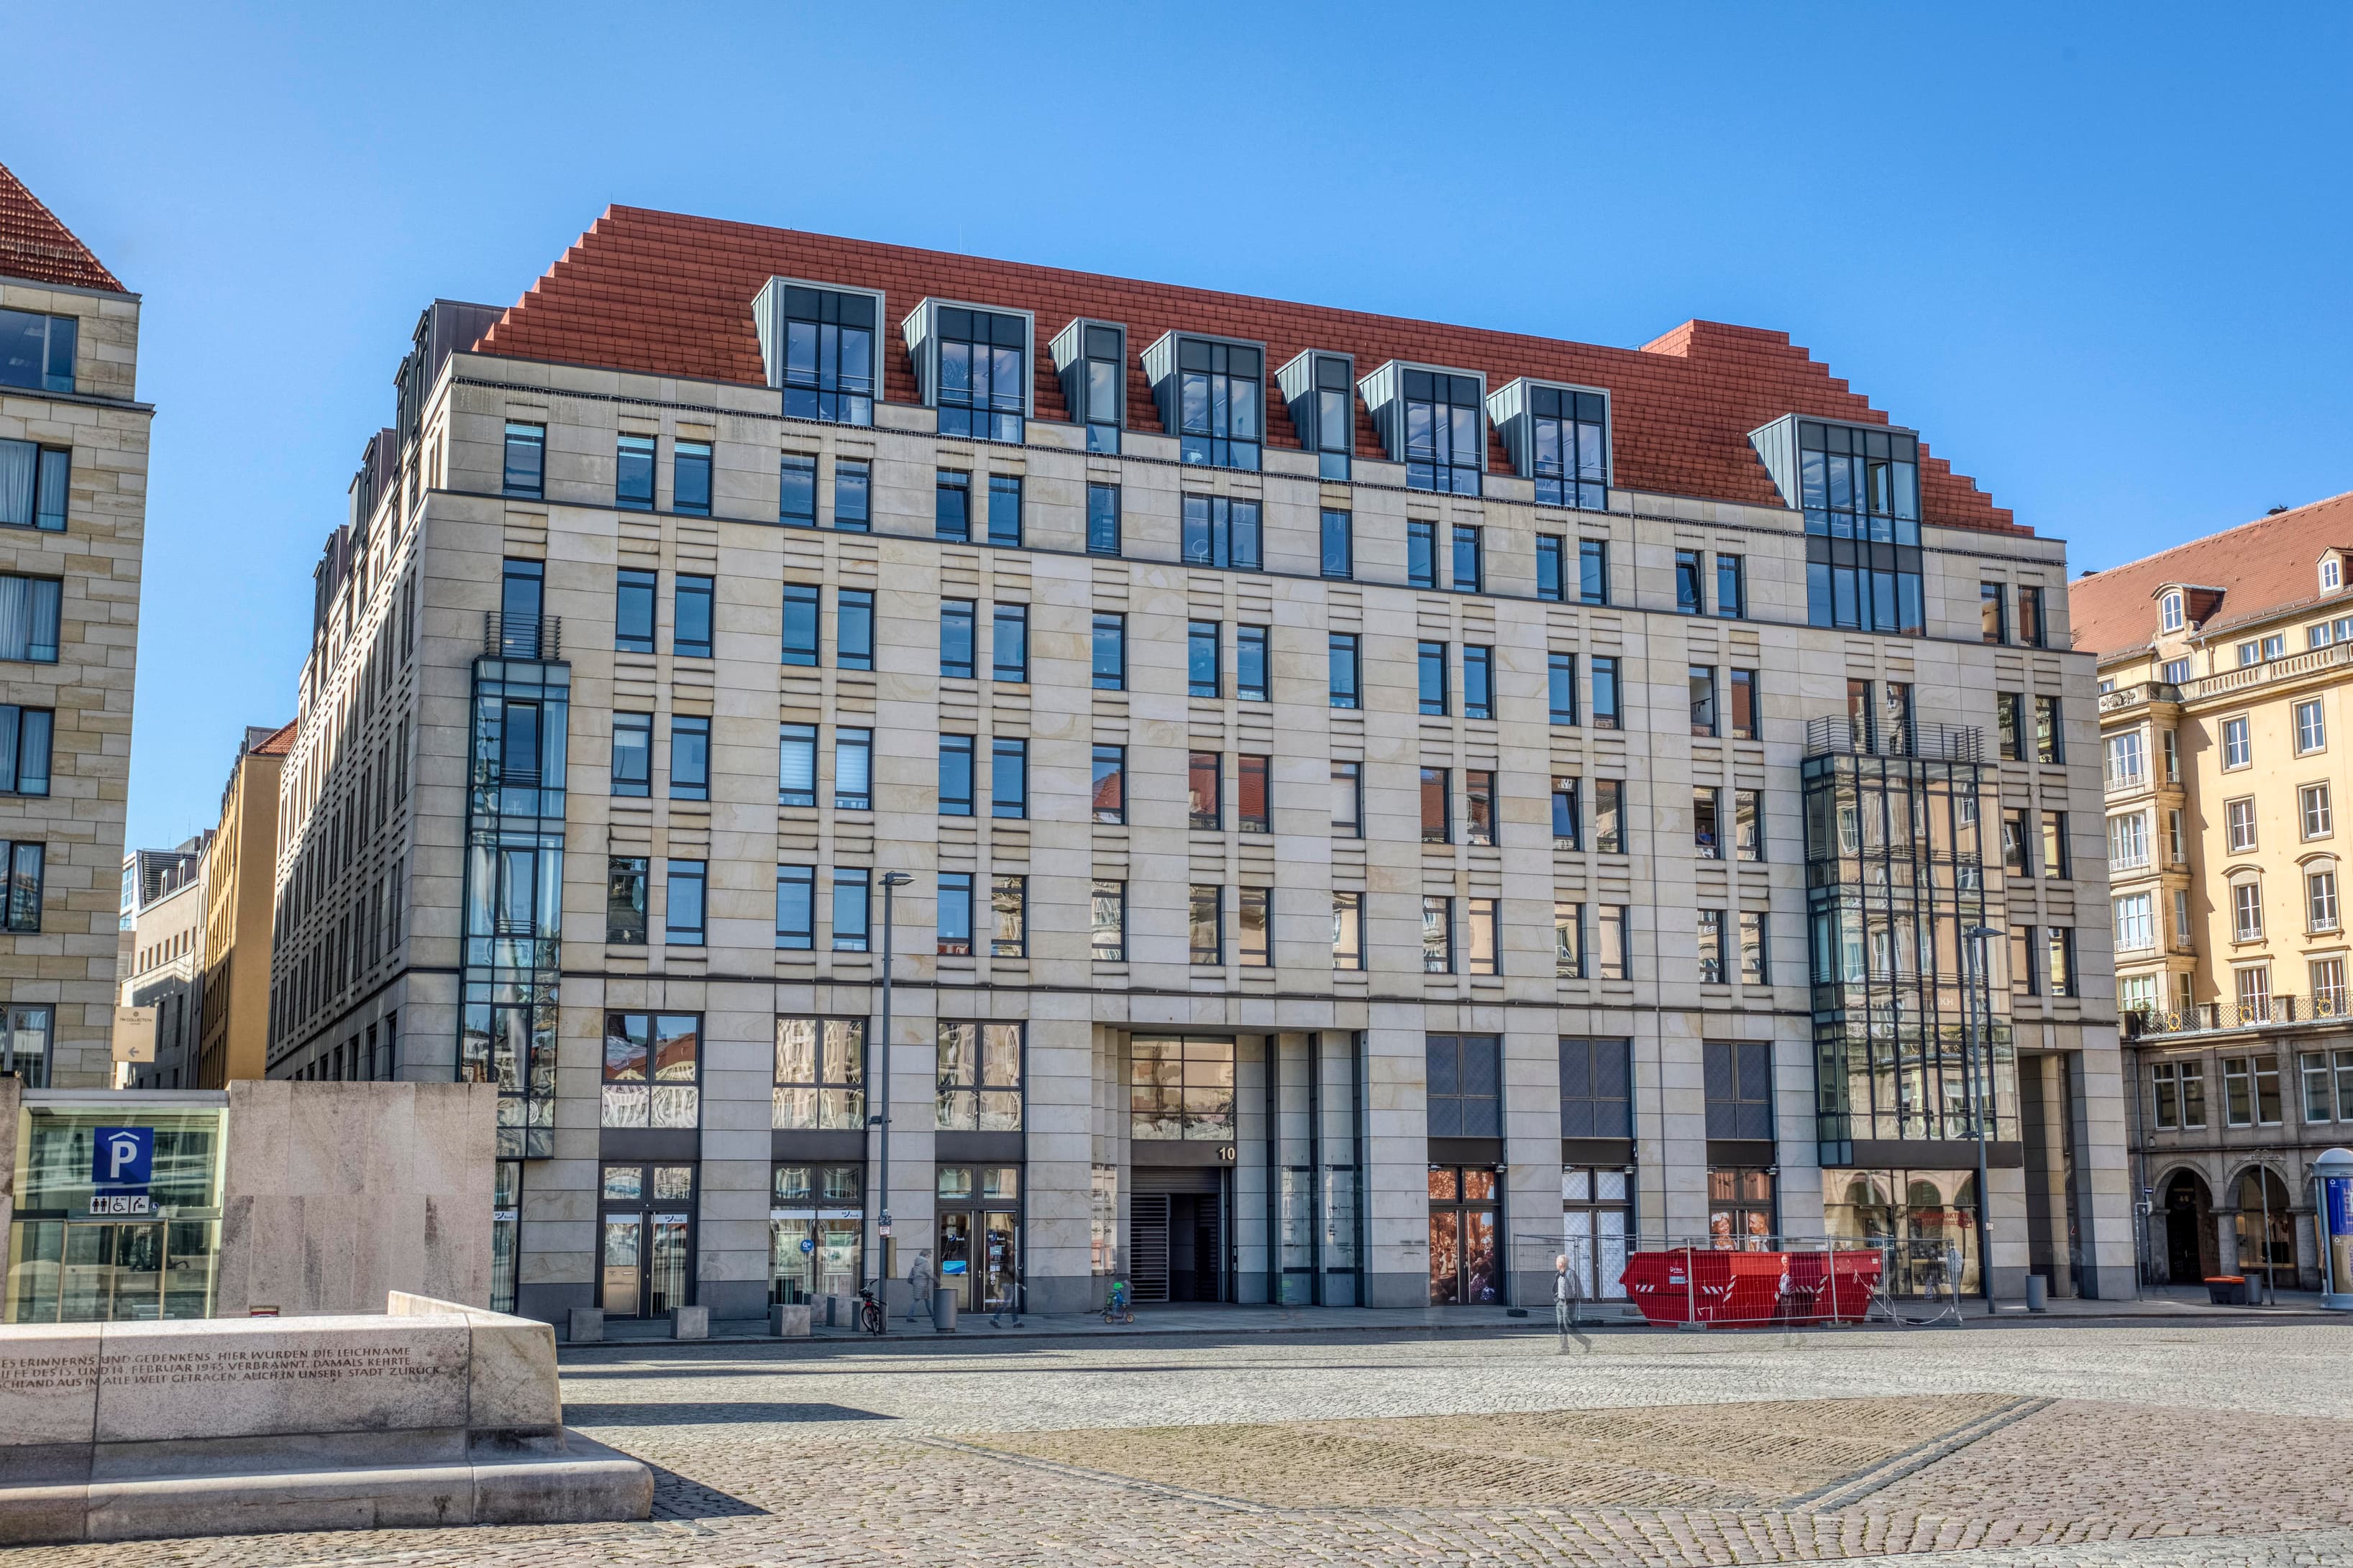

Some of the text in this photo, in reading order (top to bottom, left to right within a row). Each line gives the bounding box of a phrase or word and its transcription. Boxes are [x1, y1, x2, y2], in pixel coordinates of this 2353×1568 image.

[110, 1140, 137, 1178] P
[1220, 1147, 1235, 1160] 10
[20, 1357, 95, 1367] ERINNERNS
[219, 1352, 249, 1360] HIER
[252, 1350, 308, 1360] WURDEN
[314, 1349, 334, 1358] DIE
[338, 1347, 411, 1357] LEICHNAME
[33, 1368, 56, 1377] DES
[78, 1367, 109, 1375] UND
[132, 1364, 192, 1374] FEBRUAR
[196, 1362, 224, 1371] 1945
[314, 1358, 363, 1367] DAMALS
[367, 1357, 410, 1366] KEHRTE
[57, 1378, 81, 1387] AUS
[103, 1376, 131, 1385] ALLE
[135, 1375, 168, 1384] WELT
[243, 1370, 278, 1380] AUCH
[282, 1370, 294, 1379] IN
[298, 1369, 343, 1378] UNSERE
[349, 1367, 384, 1377] STADT
